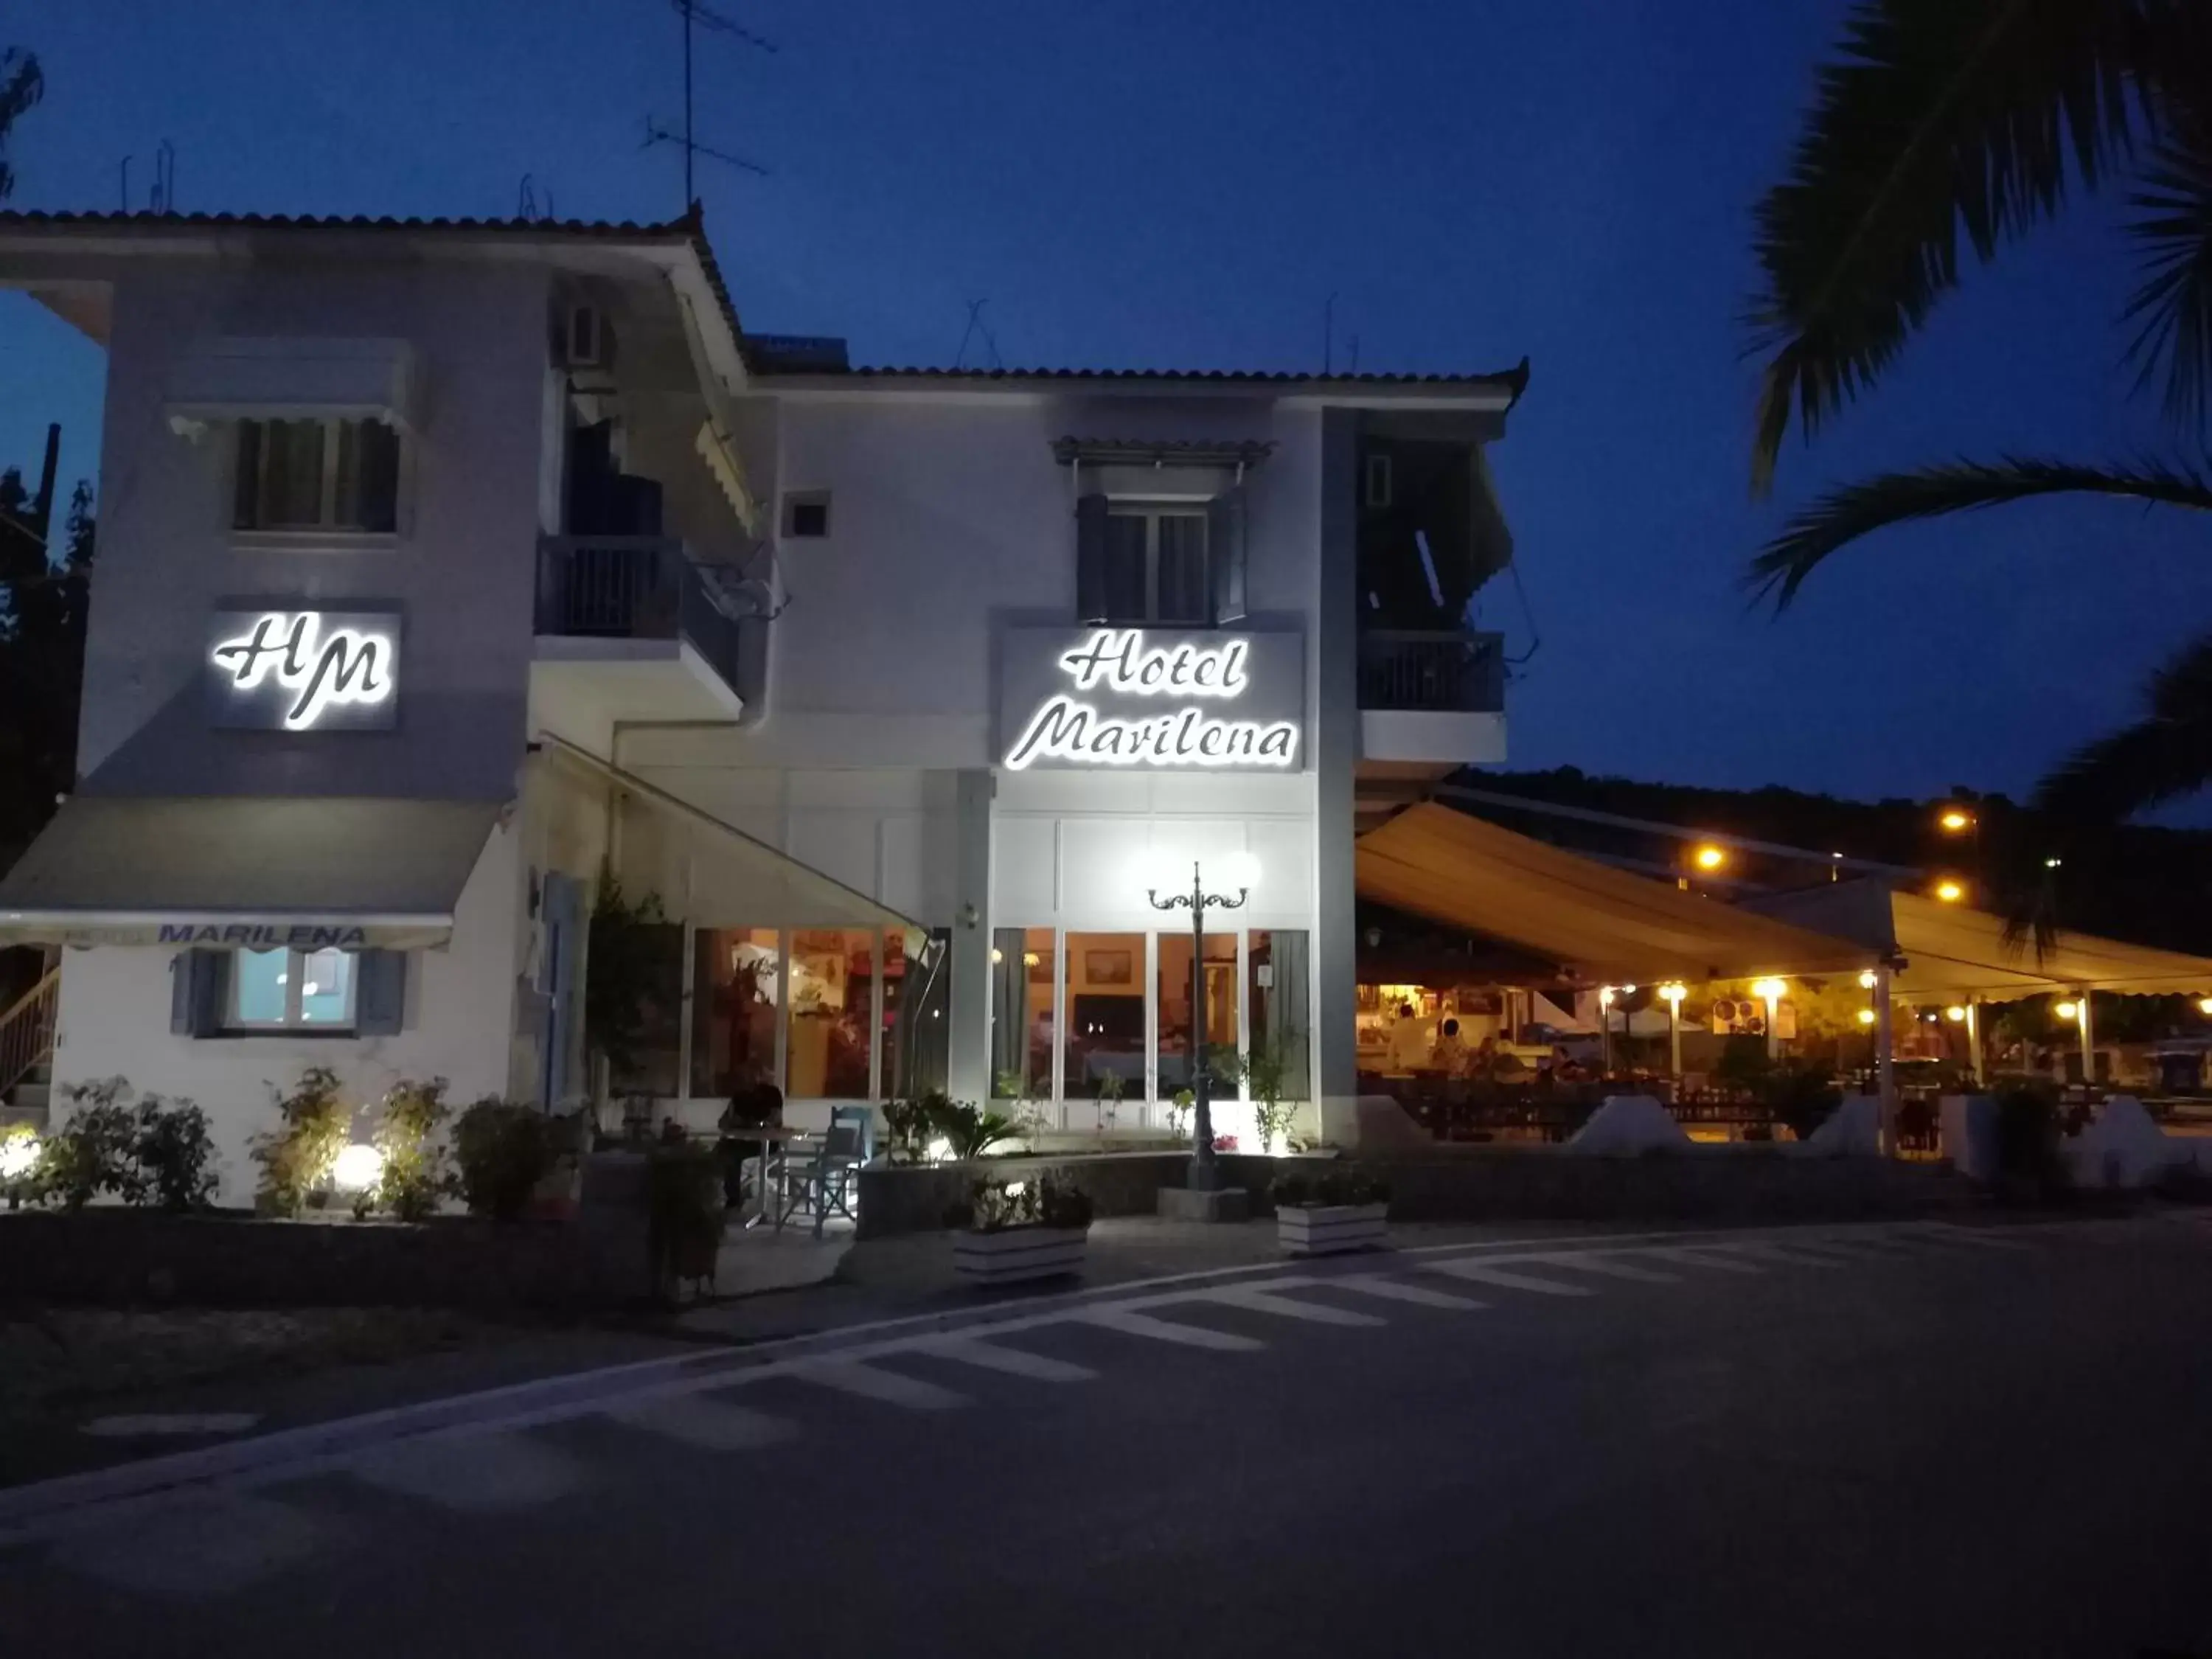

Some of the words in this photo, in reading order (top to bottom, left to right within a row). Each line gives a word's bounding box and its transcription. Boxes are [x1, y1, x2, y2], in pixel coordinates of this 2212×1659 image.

[1065, 633, 1242, 686] Hotel
[1013, 702, 1291, 762] Marilena
[158, 924, 366, 945] MARILENA
